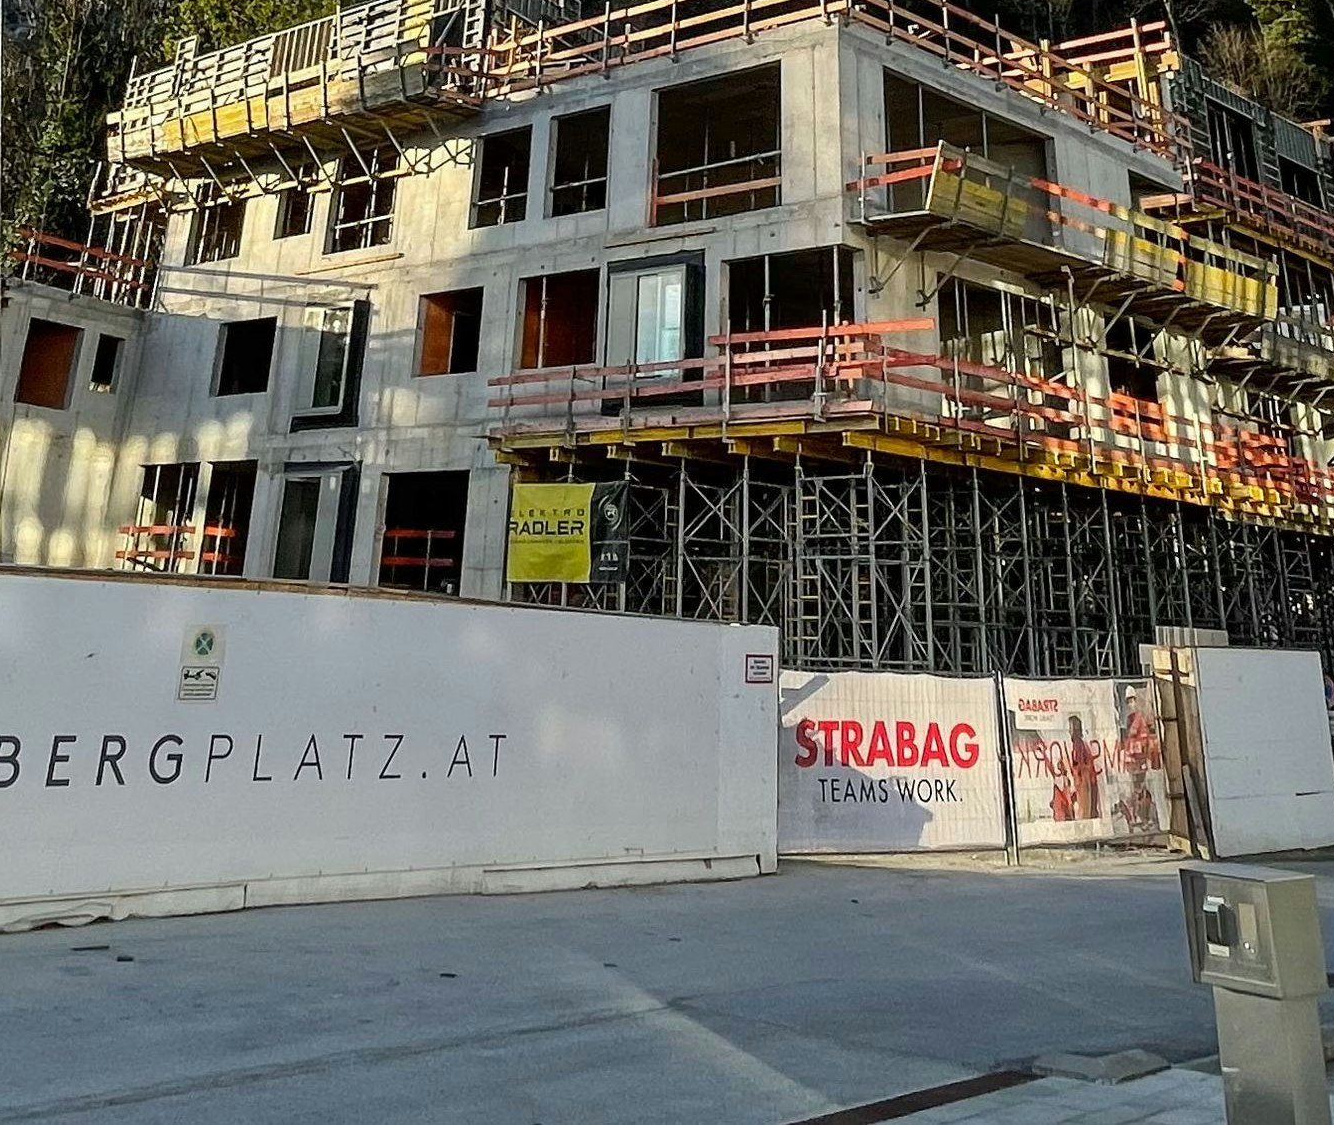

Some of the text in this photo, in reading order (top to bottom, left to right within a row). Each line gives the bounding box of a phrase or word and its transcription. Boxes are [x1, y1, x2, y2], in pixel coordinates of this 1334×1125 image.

[795, 719, 979, 769] STRABAG
[819, 779, 964, 803] TEAMS WORK.
